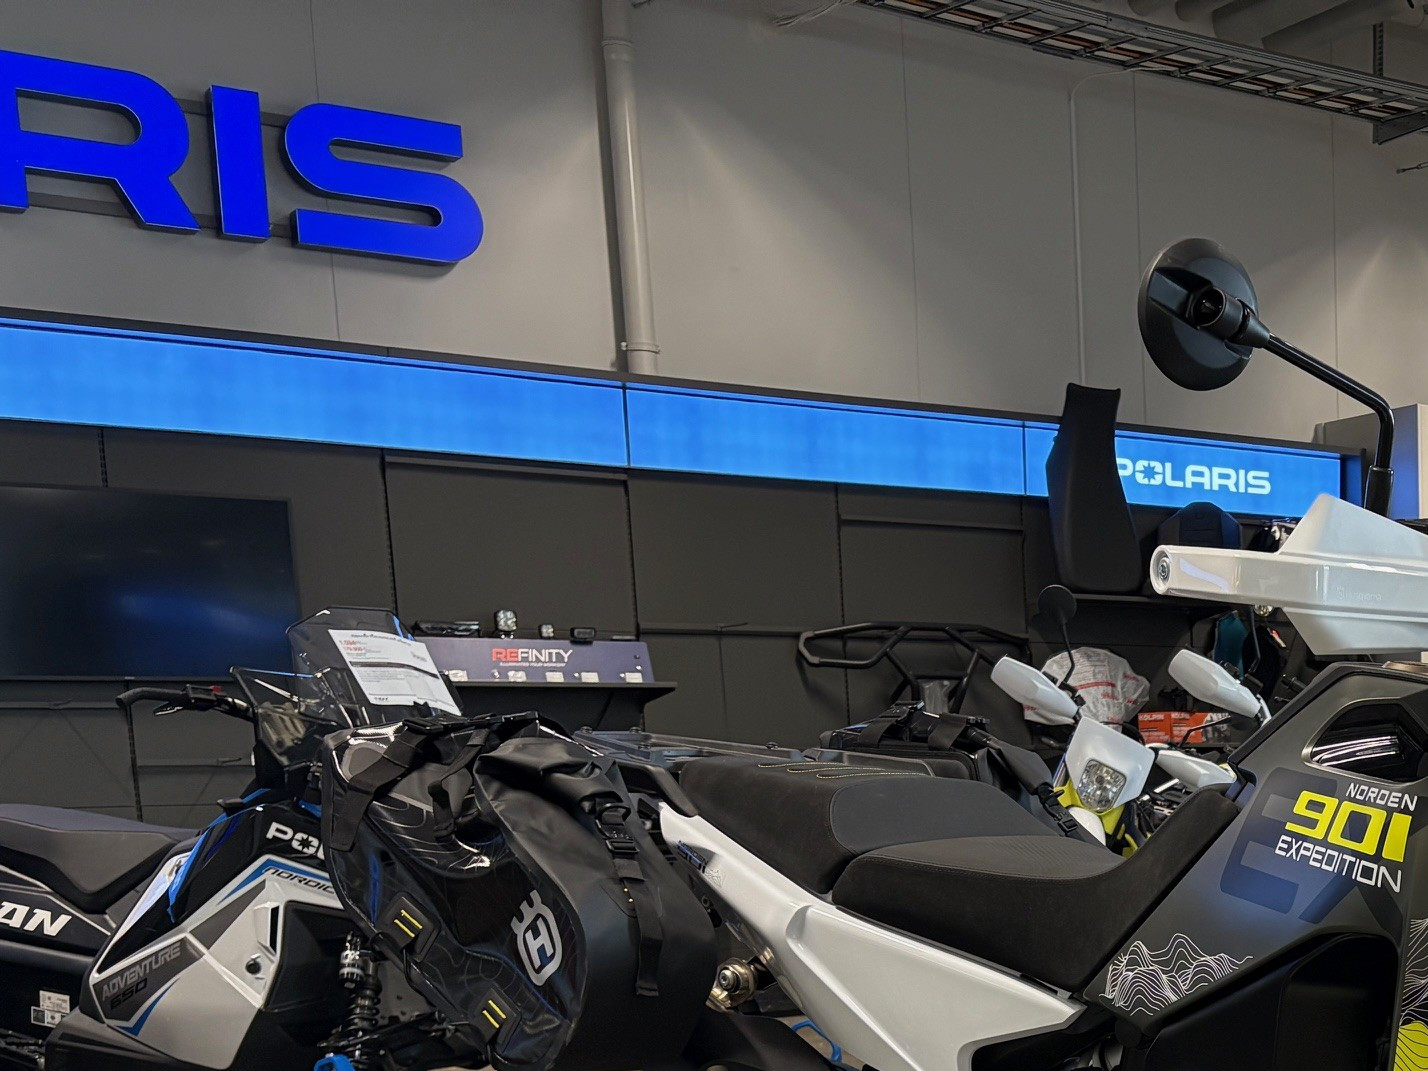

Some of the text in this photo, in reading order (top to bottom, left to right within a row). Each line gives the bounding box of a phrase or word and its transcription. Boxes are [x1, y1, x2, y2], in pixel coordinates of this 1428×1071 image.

[492, 648, 573, 663] REFINITY
[1346, 782, 1418, 811] NORDEN
[1285, 790, 1413, 863] 901
[1274, 834, 1402, 893] EXPEDITION
[102, 942, 181, 1002] ADVENTURE
